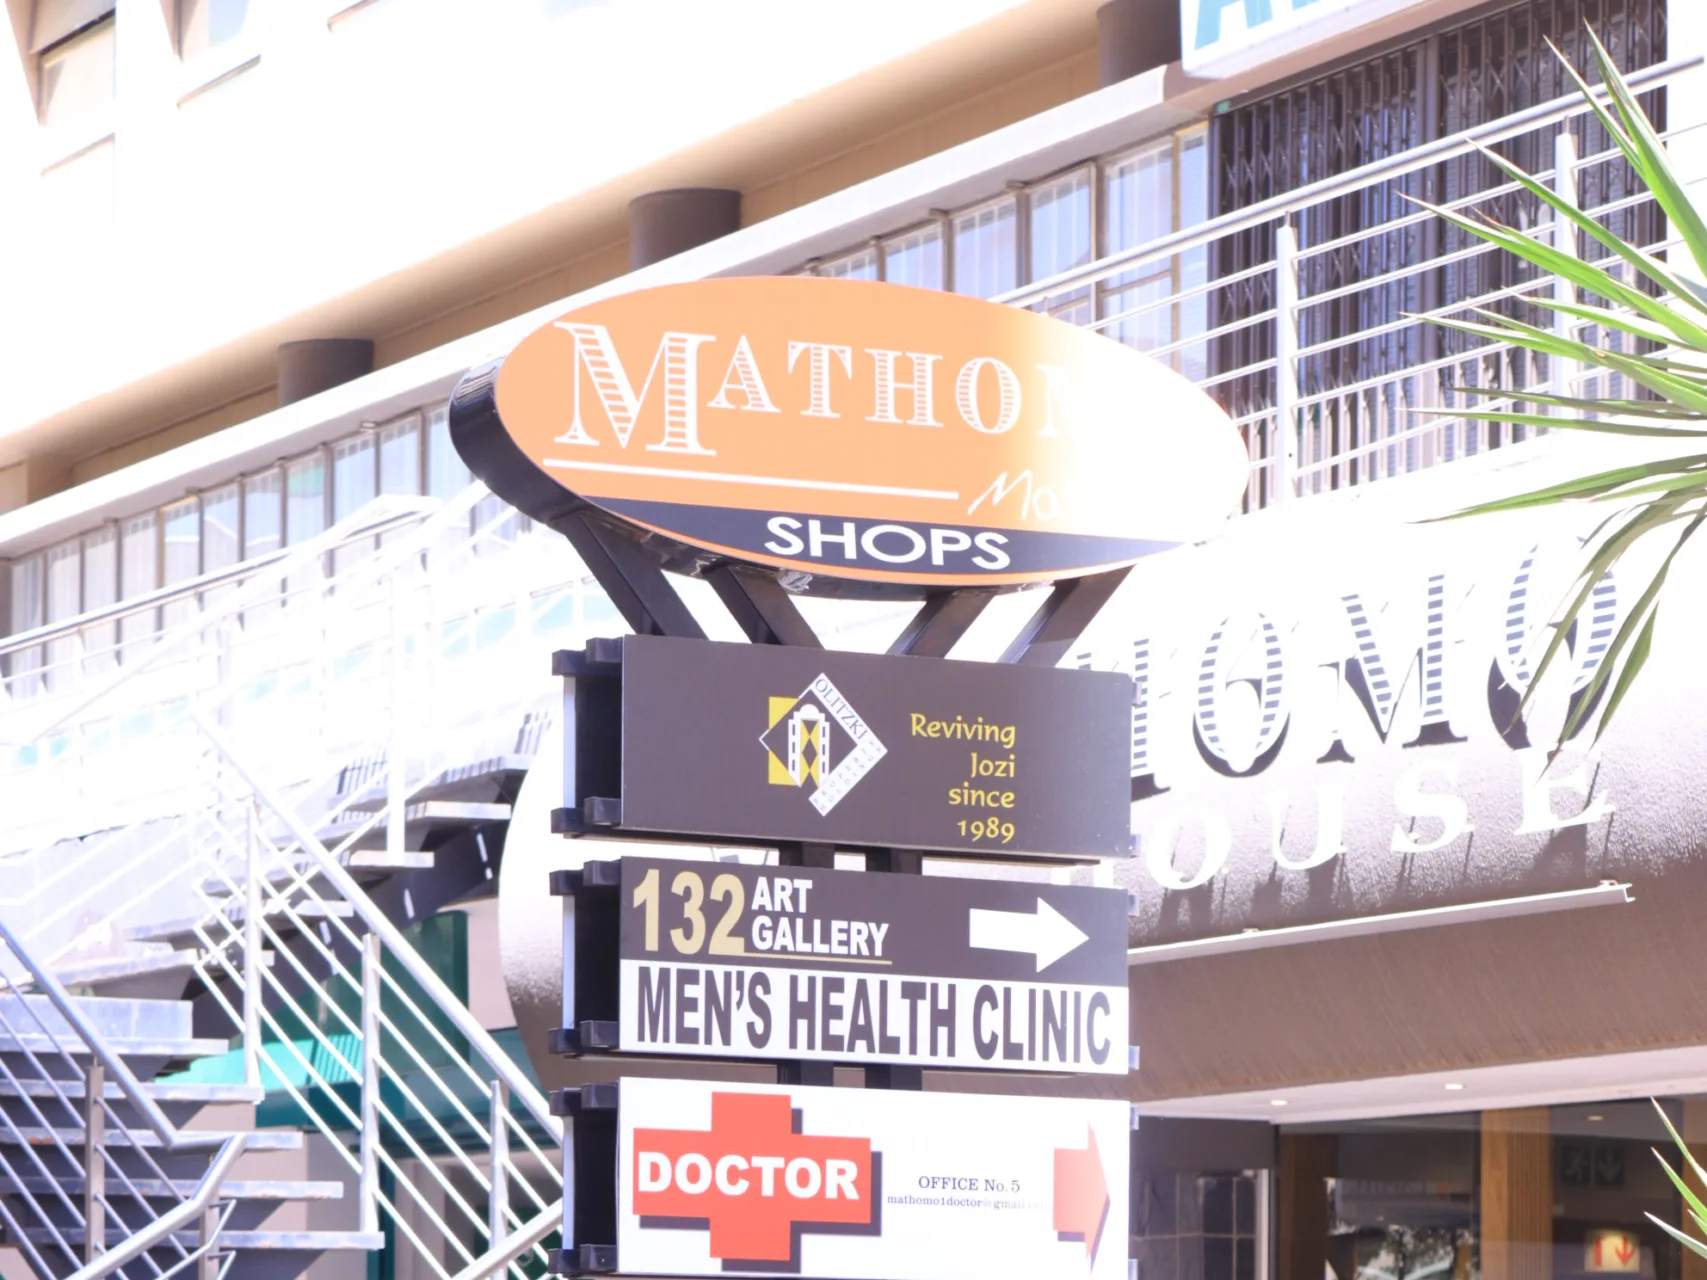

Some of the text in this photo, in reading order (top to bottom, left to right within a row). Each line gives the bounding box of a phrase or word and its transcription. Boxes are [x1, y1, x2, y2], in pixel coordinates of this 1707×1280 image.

[764, 517, 1010, 571] SHOPS
[814, 678, 868, 740] OLITZKI
[910, 713, 1016, 748] Reviving
[970, 752, 1016, 779] Jozi
[948, 786, 1016, 808] since
[957, 817, 1016, 843] 1989
[1094, 747, 1617, 890] OUSE
[632, 868, 745, 956] 132
[751, 876, 813, 913] ART
[751, 916, 889, 957] GALLERY
[637, 965, 1111, 1065] MEN'S HEALTH CLINIC
[638, 1150, 860, 1200] DOCTOR
[918, 1176, 979, 1191] OFFICE
[1011, 1180, 1020, 1194] 5
